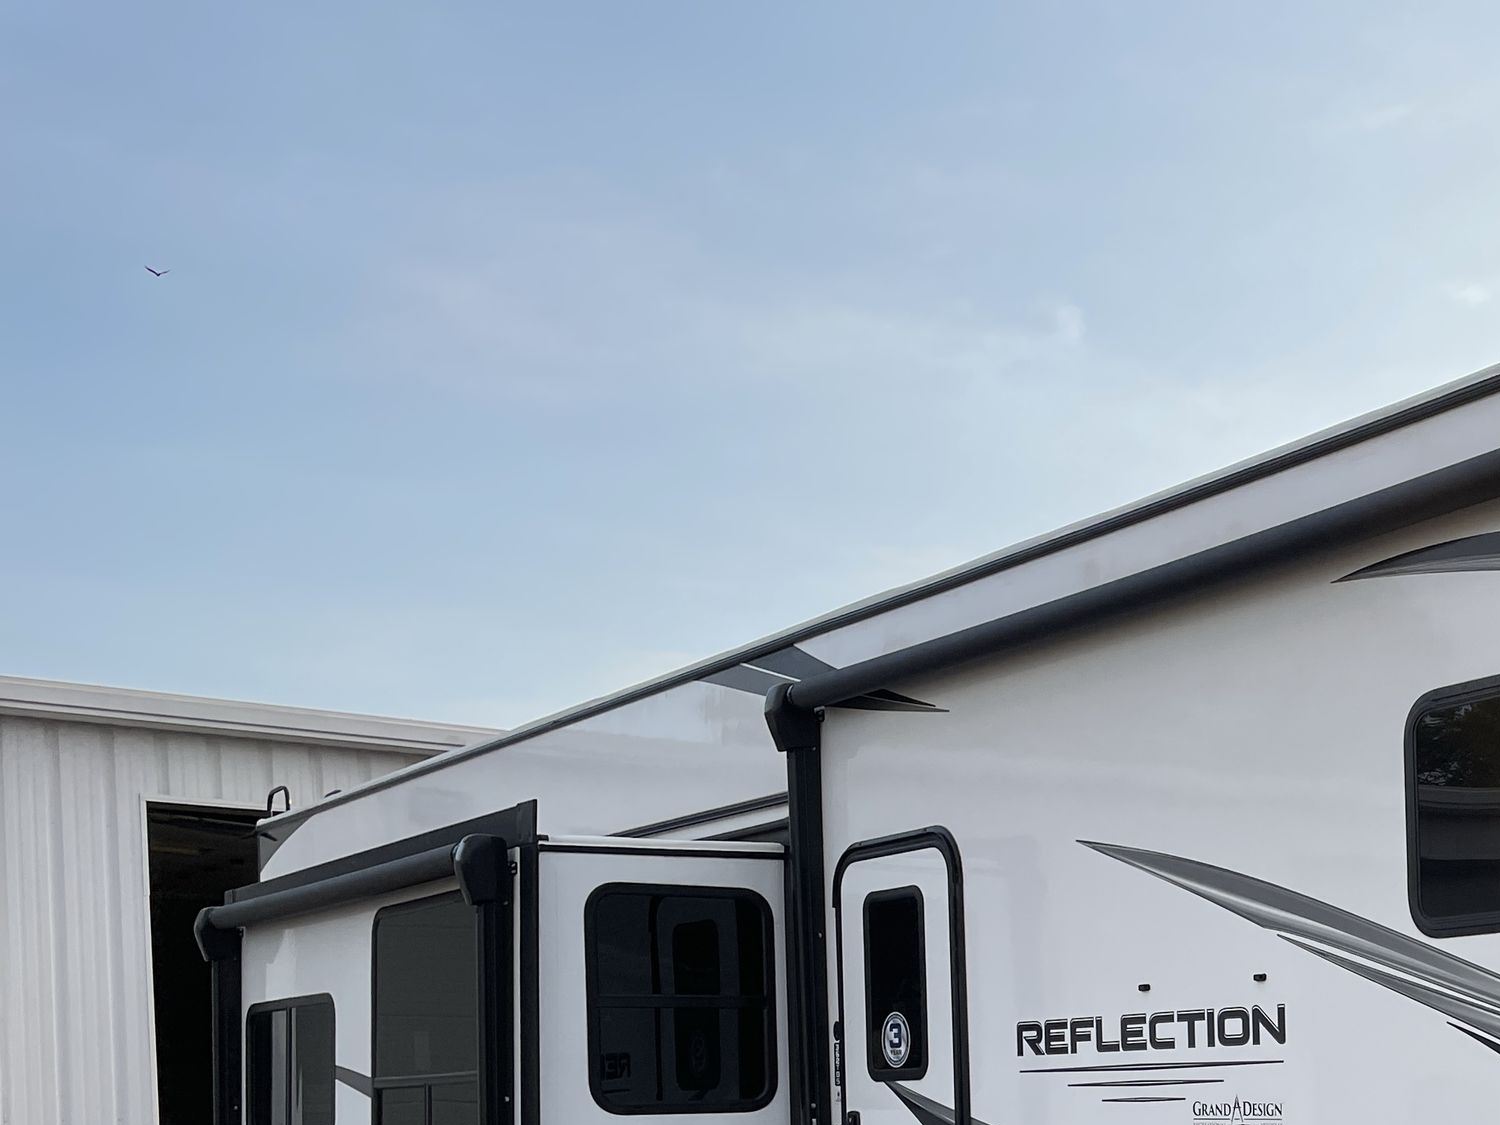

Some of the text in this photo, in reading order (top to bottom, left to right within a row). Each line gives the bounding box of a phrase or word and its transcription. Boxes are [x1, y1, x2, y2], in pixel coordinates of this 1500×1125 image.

[889, 1023, 902, 1048] 3
[1016, 1004, 1286, 1057] REFLECTION
[1192, 1101, 1283, 1116] GRAND DESIGN
